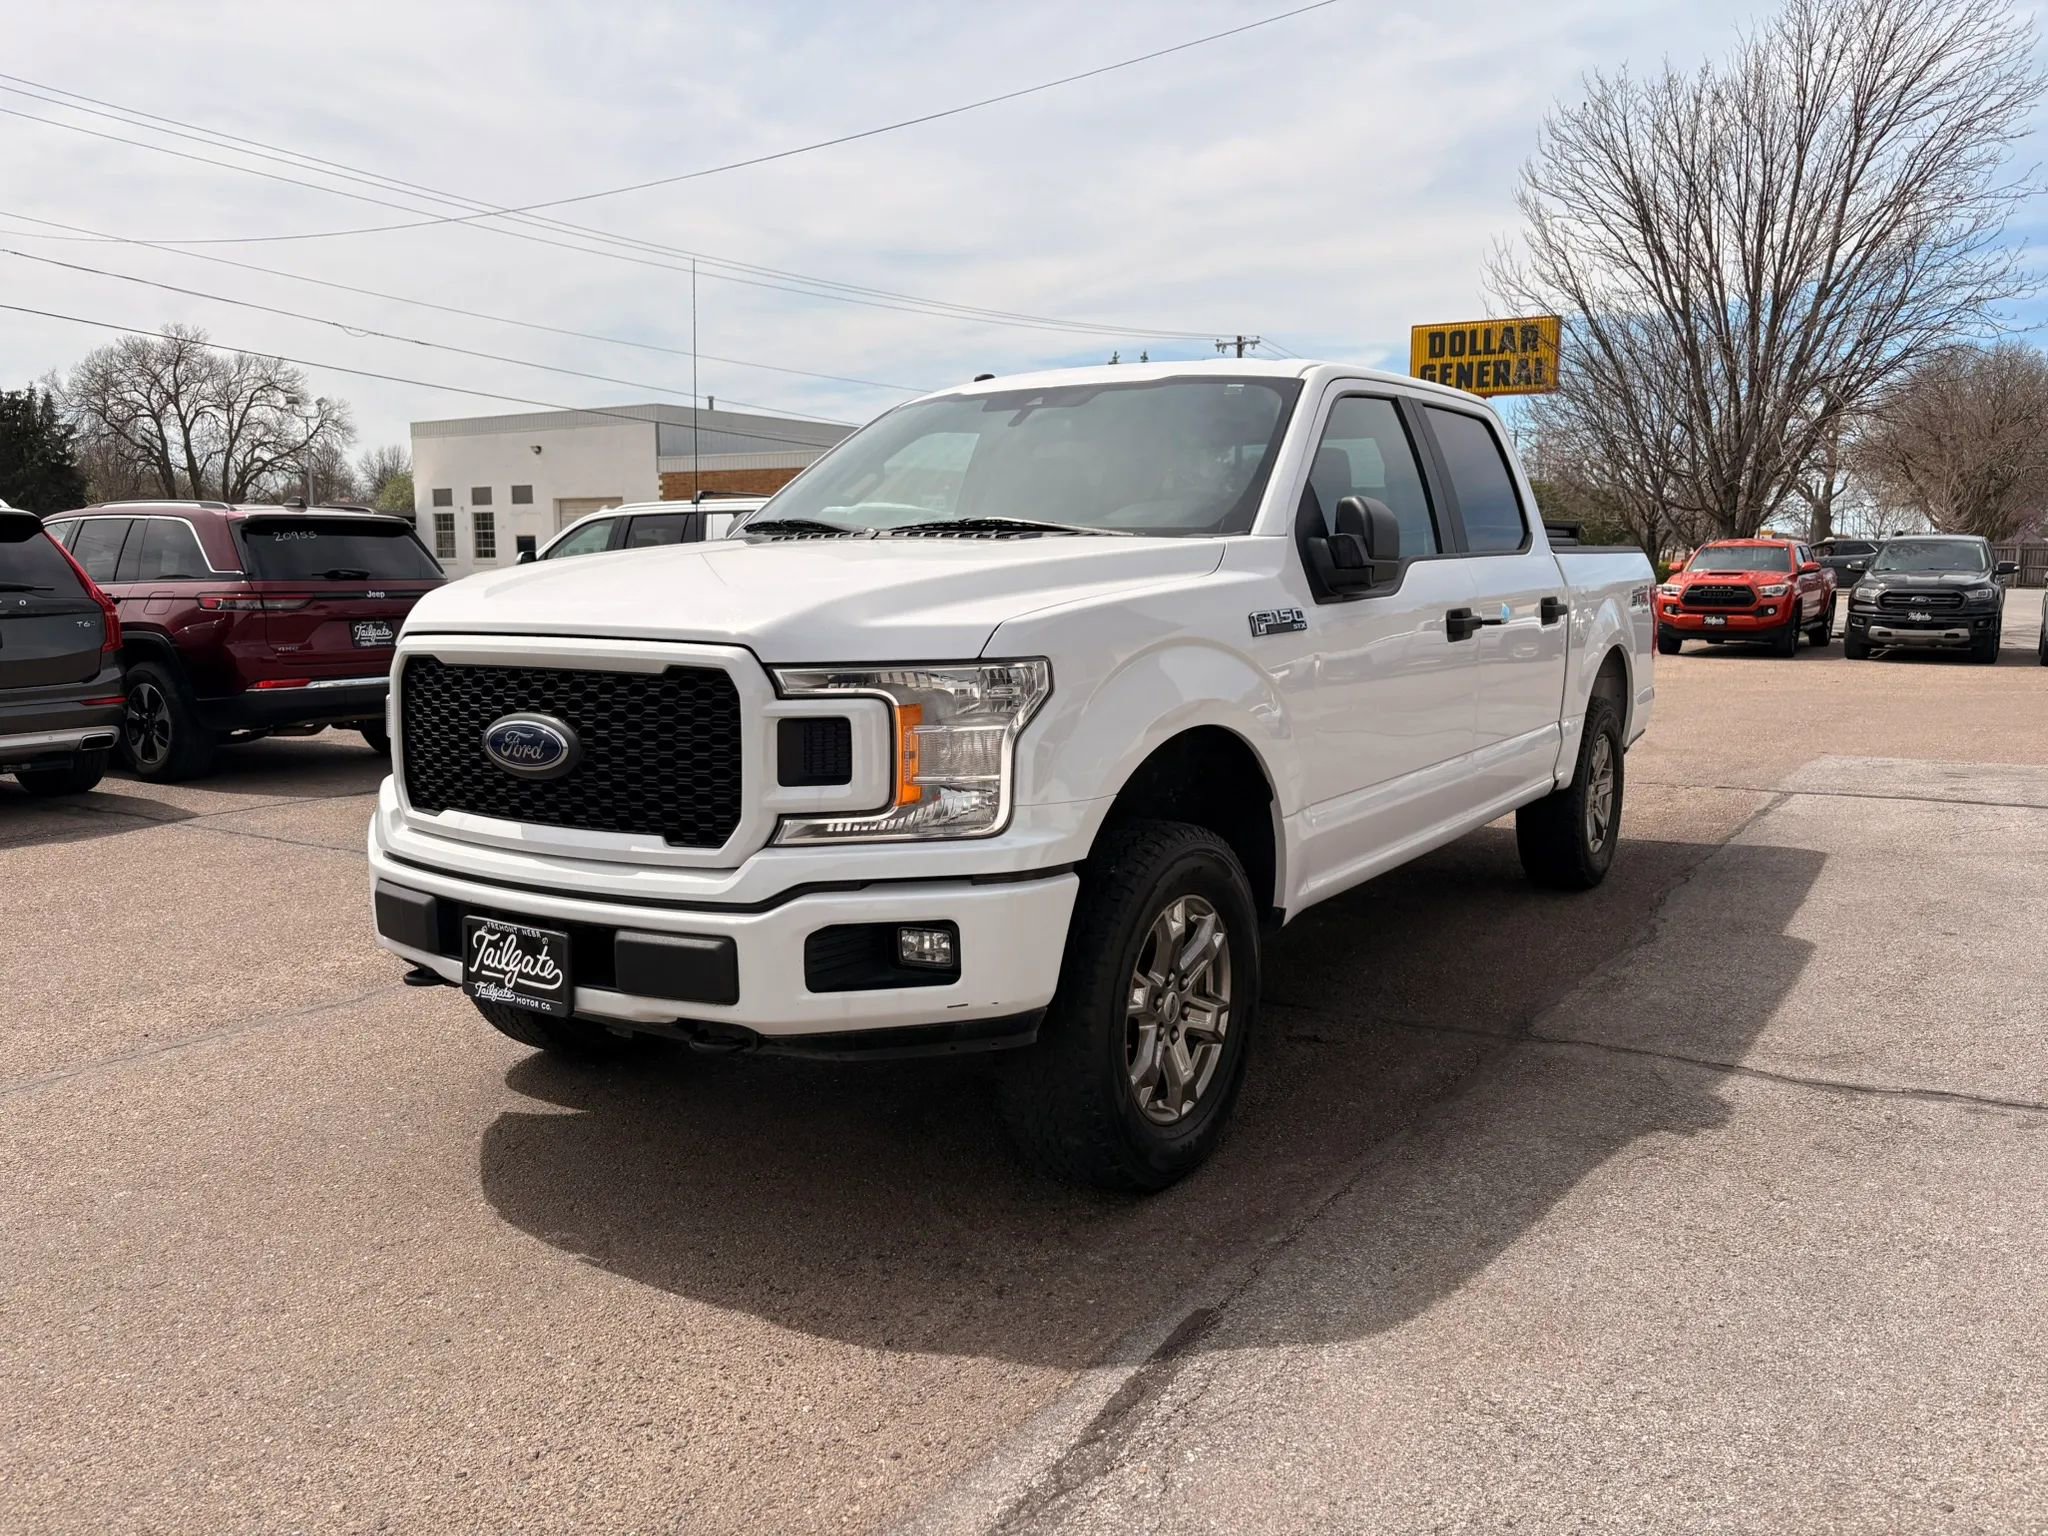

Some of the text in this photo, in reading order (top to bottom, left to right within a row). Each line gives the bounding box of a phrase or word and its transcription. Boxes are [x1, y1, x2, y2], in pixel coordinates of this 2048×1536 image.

[1428, 325, 1539, 358] DOLLAR
[1420, 358, 1544, 389] GENERAL
[273, 531, 318, 542] 20955
[366, 590, 386, 599] Jeep
[354, 624, 393, 641] Tailgate
[501, 730, 545, 759] Ford
[486, 921, 518, 935] FREMONT
[469, 930, 563, 989] Tailgate
[475, 981, 515, 1001] Tailgate
[516, 997, 539, 1008] MOTOR
